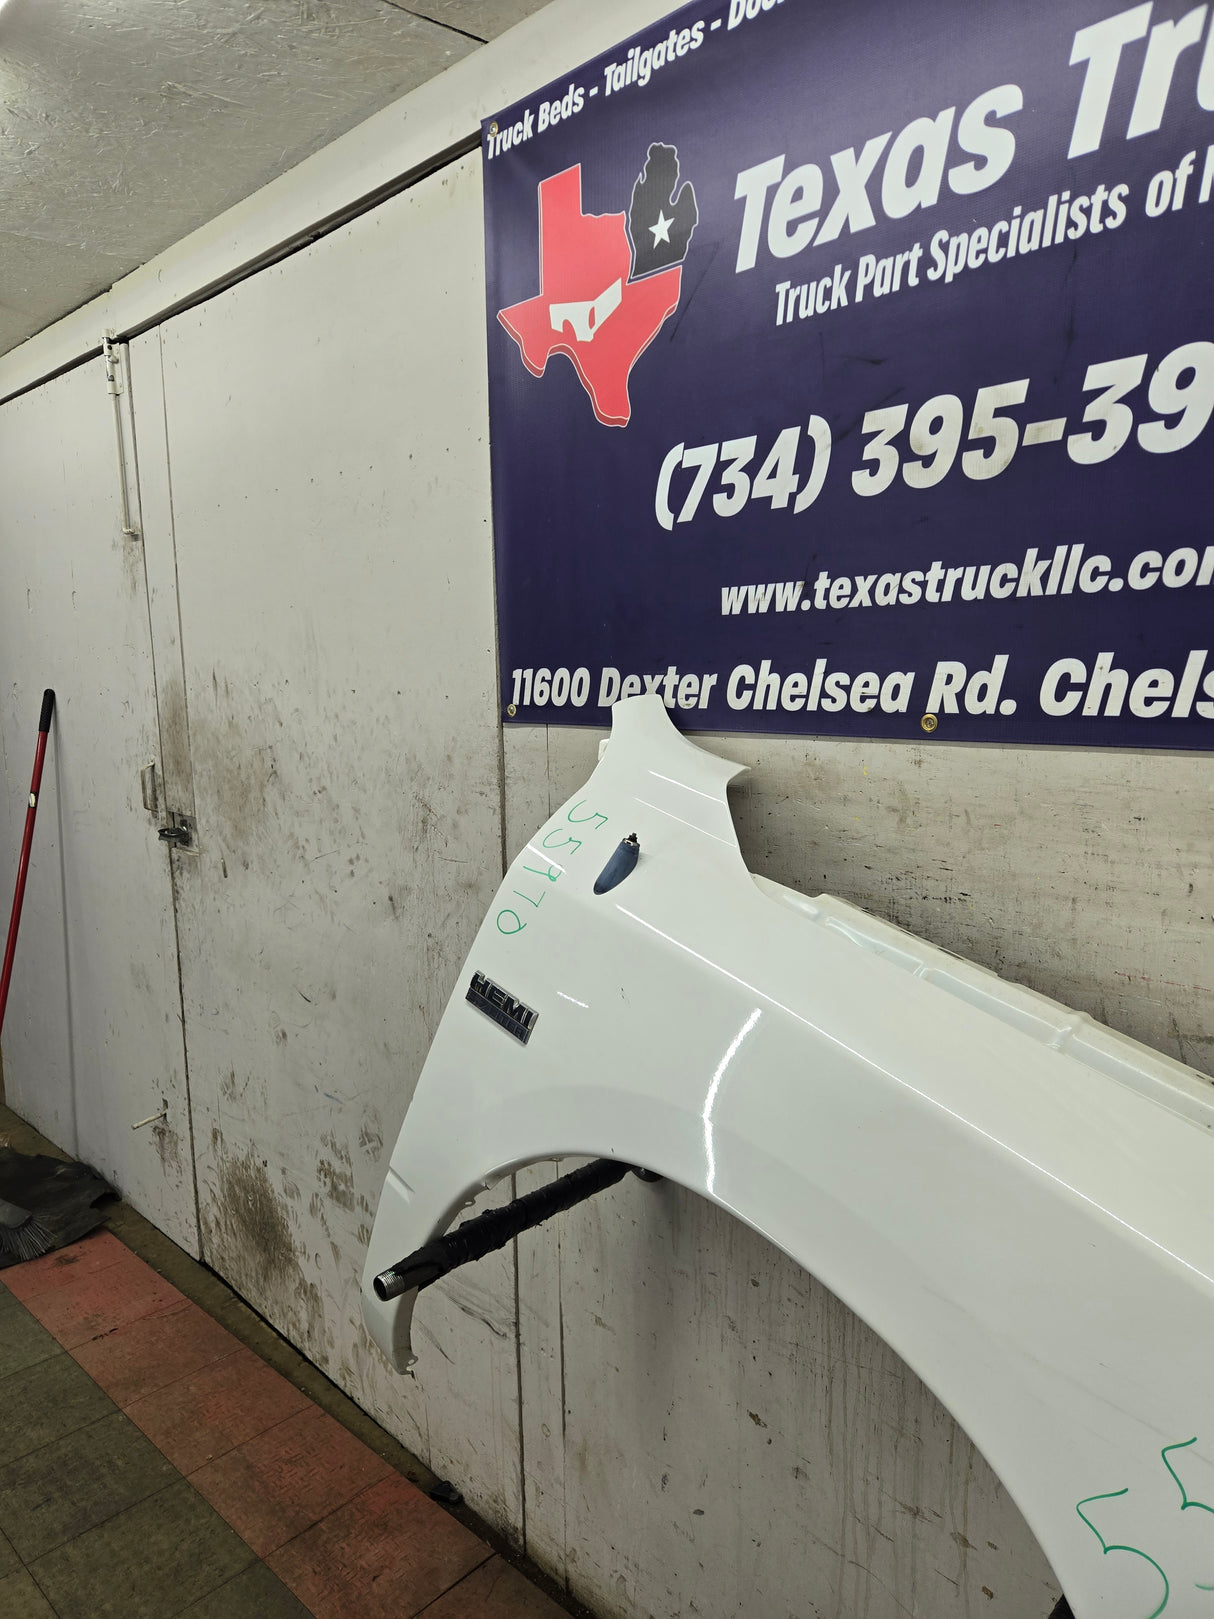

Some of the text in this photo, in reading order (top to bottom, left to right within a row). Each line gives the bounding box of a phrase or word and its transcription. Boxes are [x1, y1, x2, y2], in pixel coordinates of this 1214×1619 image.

[486, 108, 535, 160] Truck
[537, 81, 585, 133] Beds
[603, 20, 705, 97] Tailgates
[734, 0, 1214, 274] Texas Tr
[774, 264, 852, 327] Truck
[855, 242, 923, 303] Part
[925, 183, 1131, 284] Specialists
[1144, 149, 1198, 219] of
[655, 341, 1214, 532] (734) 395-39
[511, 666, 591, 707] 11600
[597, 665, 718, 710] Dexter
[726, 658, 916, 714] Chelsea
[925, 654, 1017, 715] Rd.
[469, 969, 540, 1029] HEMI
